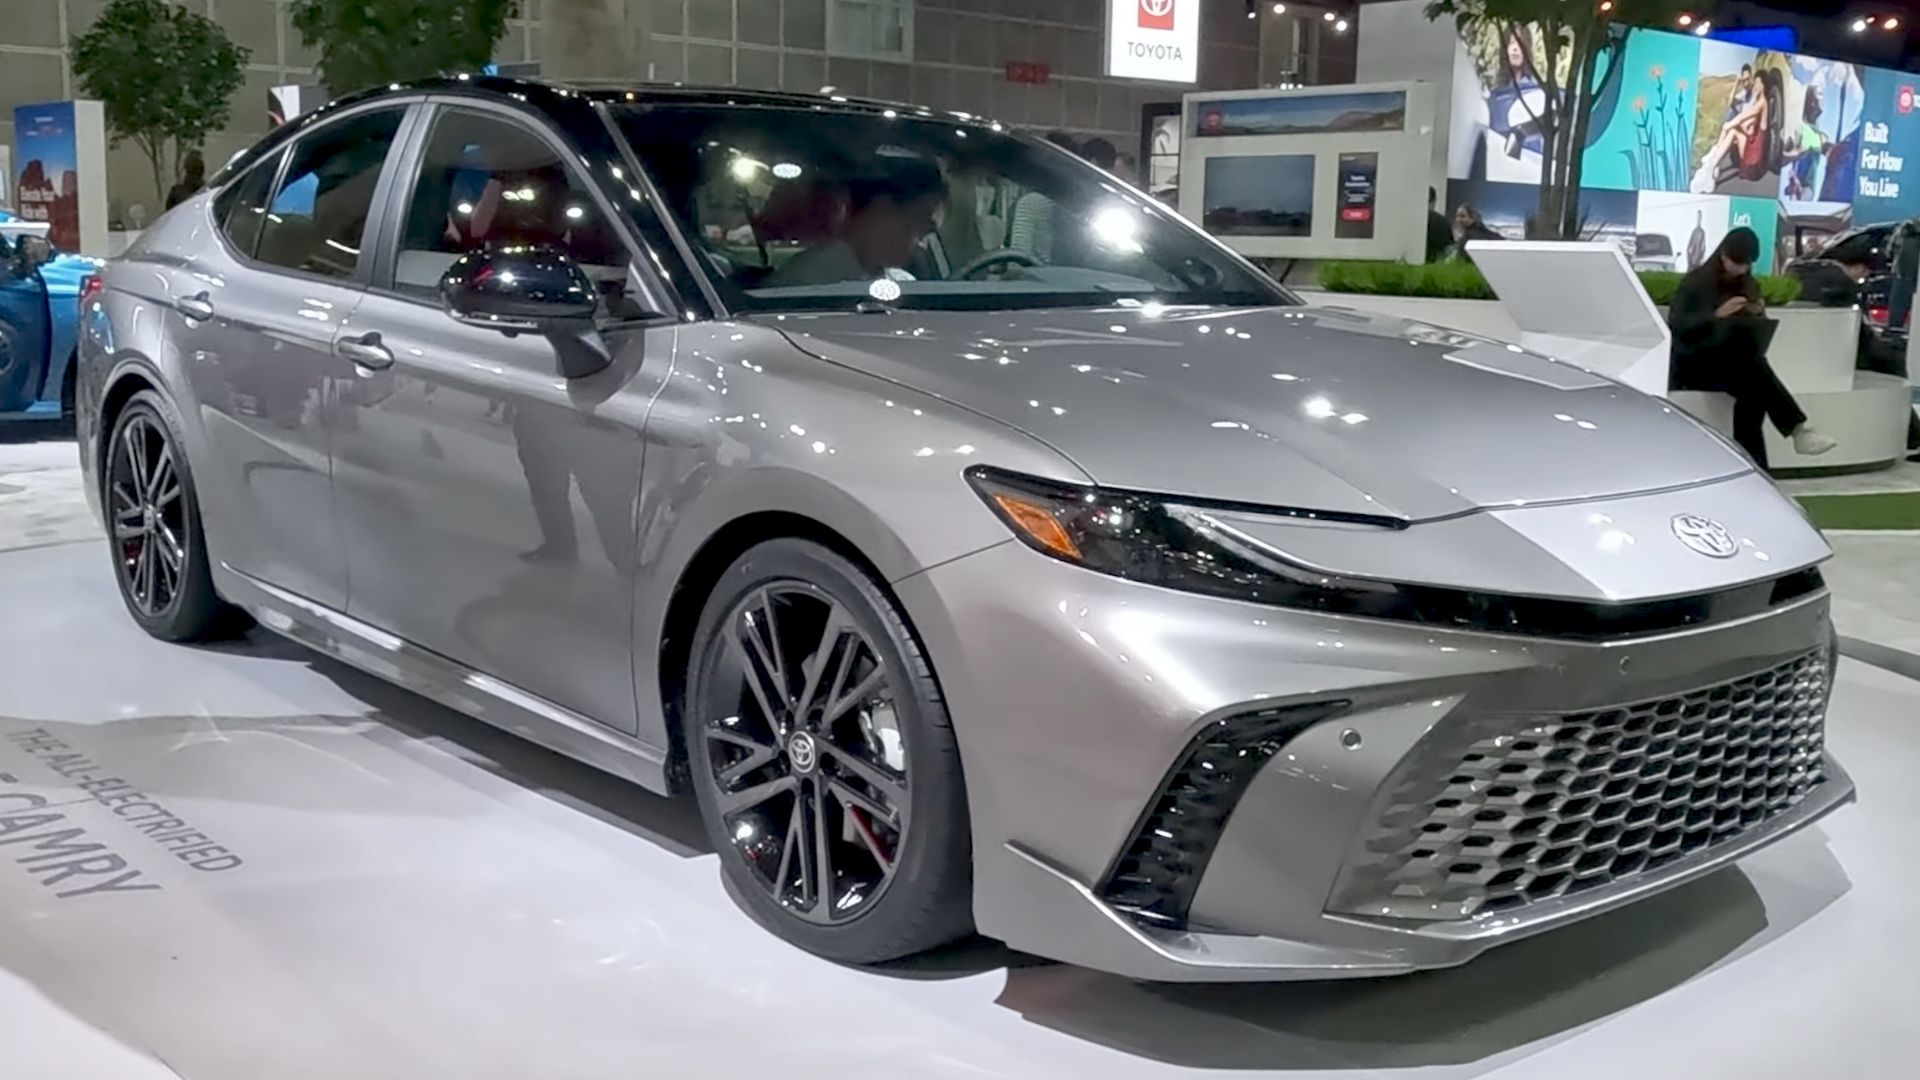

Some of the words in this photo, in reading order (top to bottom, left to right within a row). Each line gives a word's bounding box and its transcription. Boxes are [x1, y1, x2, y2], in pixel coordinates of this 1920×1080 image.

[1127, 41, 1183, 61] TOYOTA
[1864, 121, 1889, 144] Built
[1861, 148, 1879, 170] For
[1879, 150, 1904, 172] How
[1859, 175, 1879, 196] You
[1879, 177, 1899, 198] Live
[4, 727, 70, 754] THE
